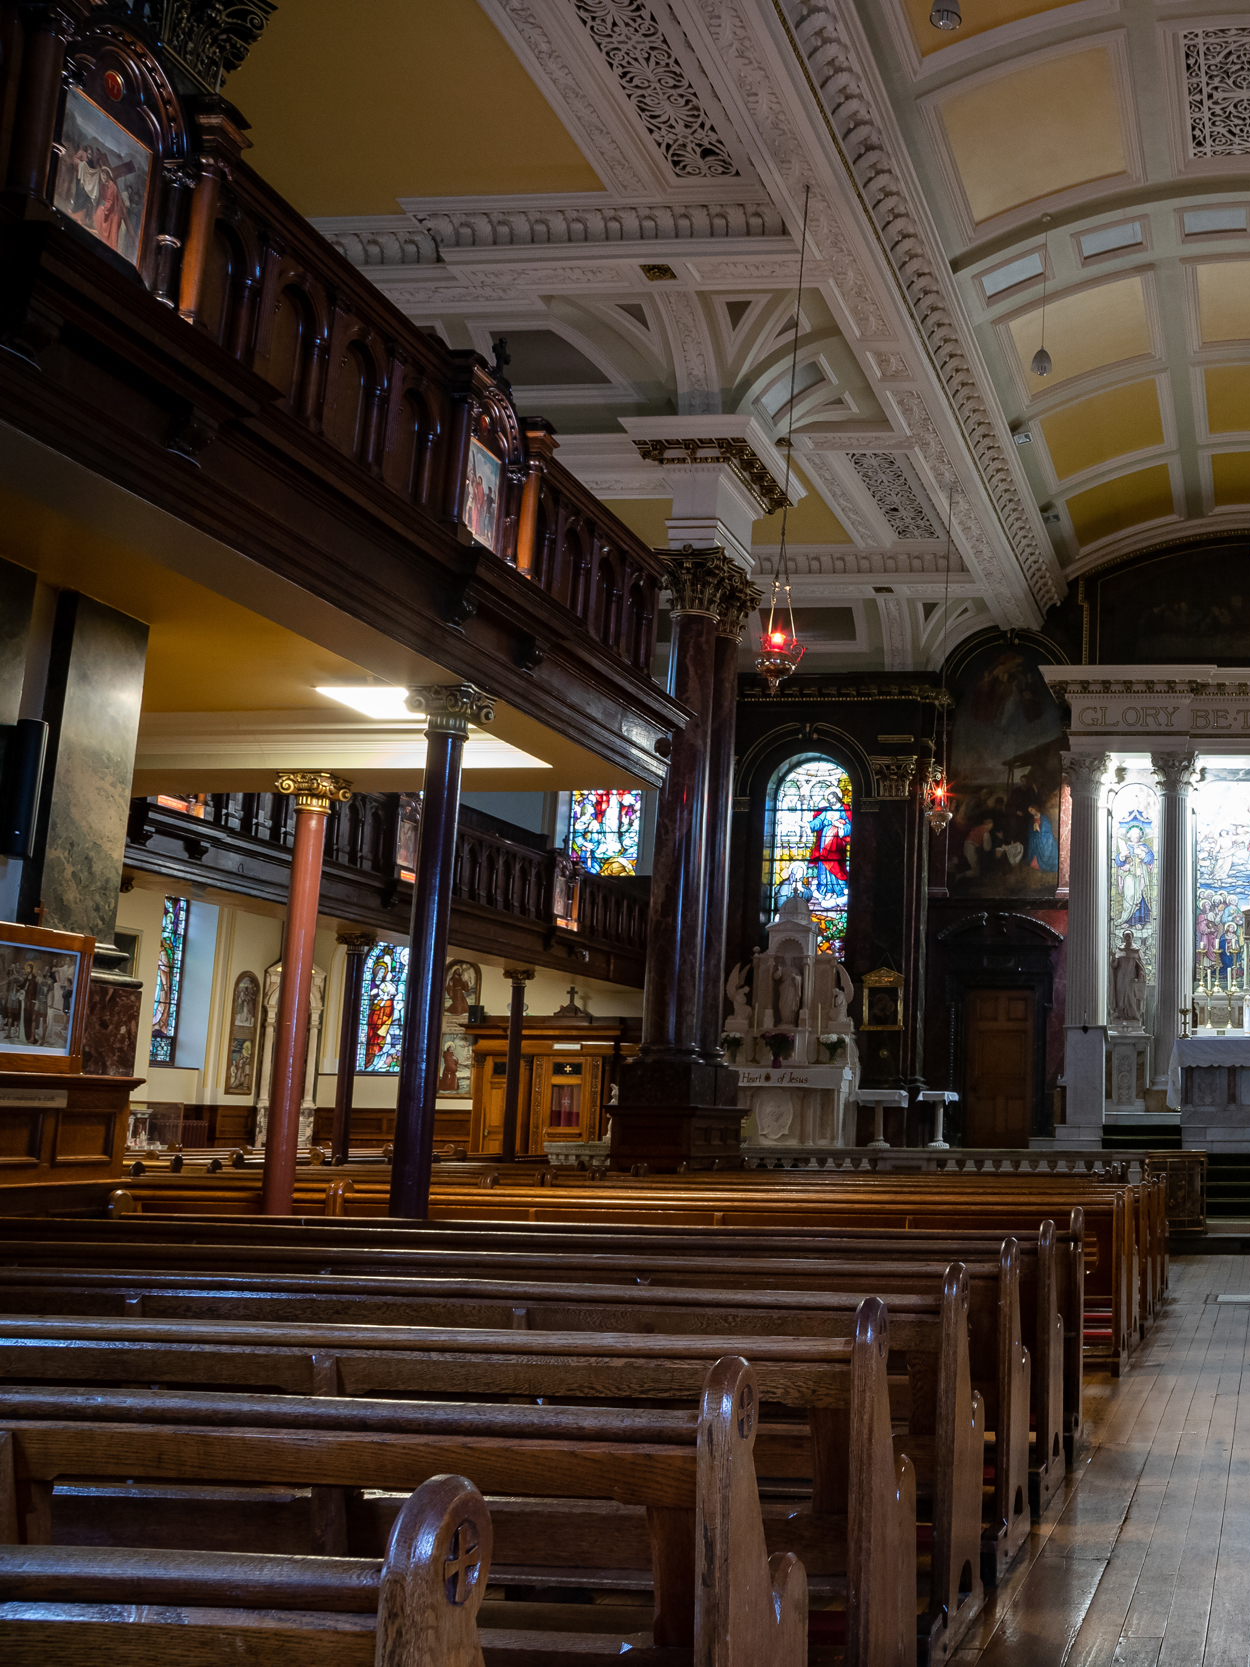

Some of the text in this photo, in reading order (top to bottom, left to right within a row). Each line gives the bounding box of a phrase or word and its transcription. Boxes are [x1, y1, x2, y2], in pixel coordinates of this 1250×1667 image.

[1078, 706, 1180, 727] GLORY
[741, 1072, 762, 1083] Heart
[777, 1072, 787, 1085] of
[787, 1071, 809, 1084] Jesus
